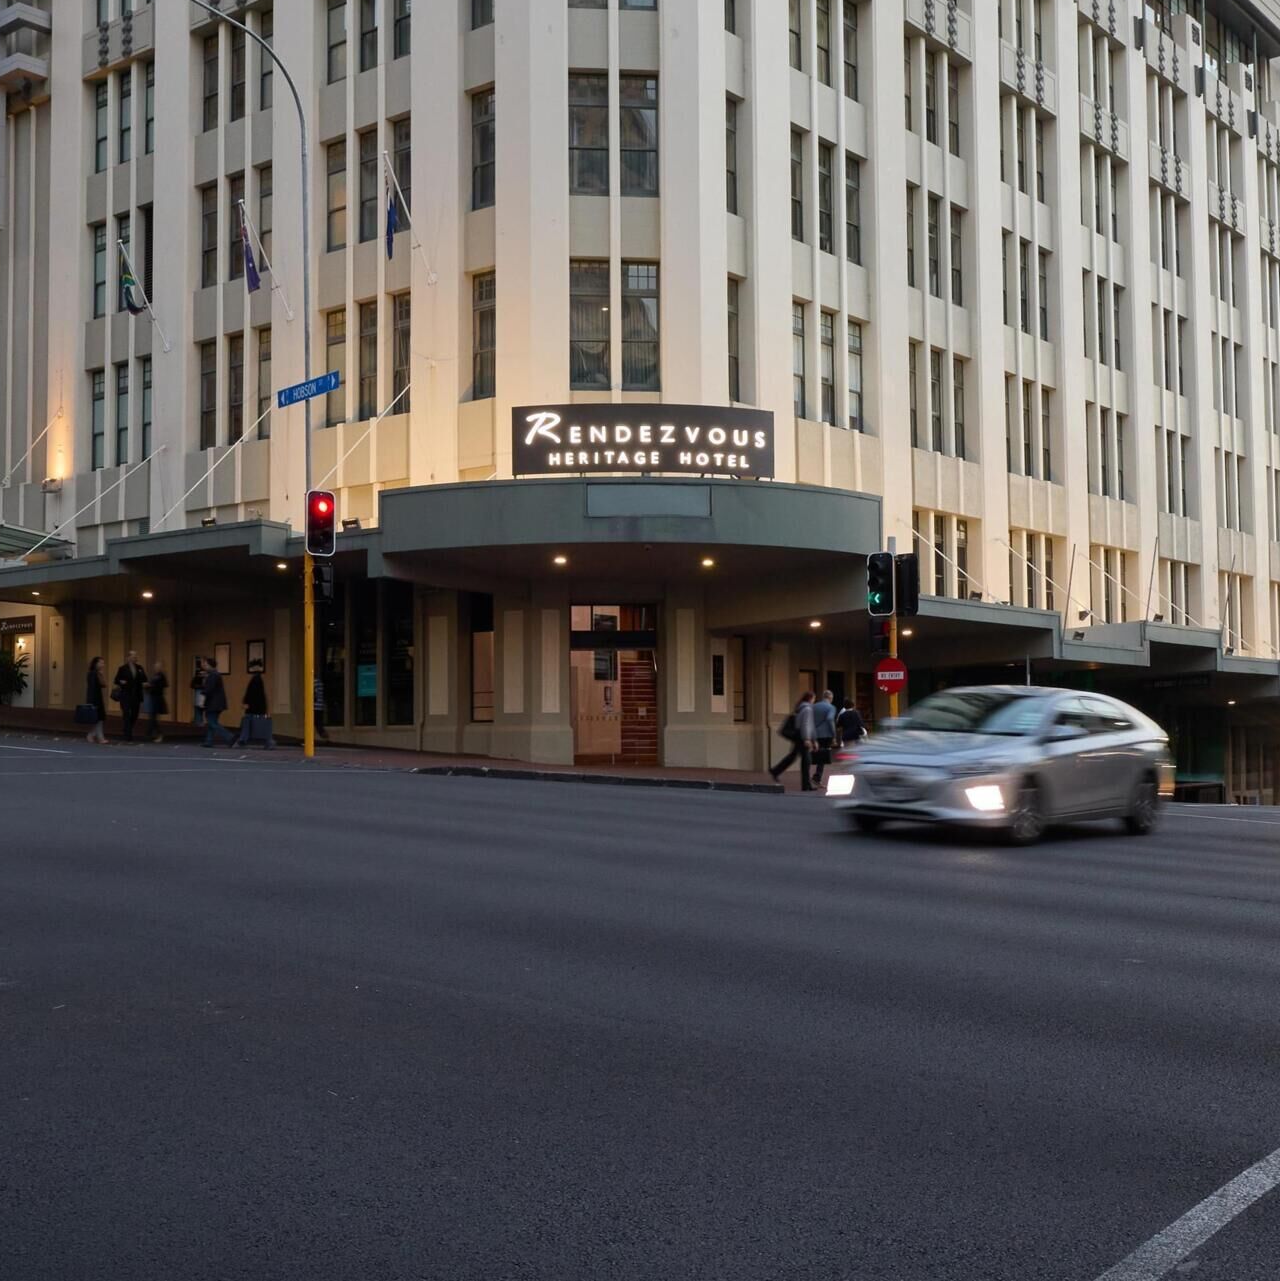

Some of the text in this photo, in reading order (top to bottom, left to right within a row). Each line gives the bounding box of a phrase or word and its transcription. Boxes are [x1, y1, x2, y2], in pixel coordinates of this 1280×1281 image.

[292, 382, 317, 400] HOBSON
[524, 411, 766, 449] RENDEZVOUS
[548, 451, 750, 468] HERITAGE HOTEL
